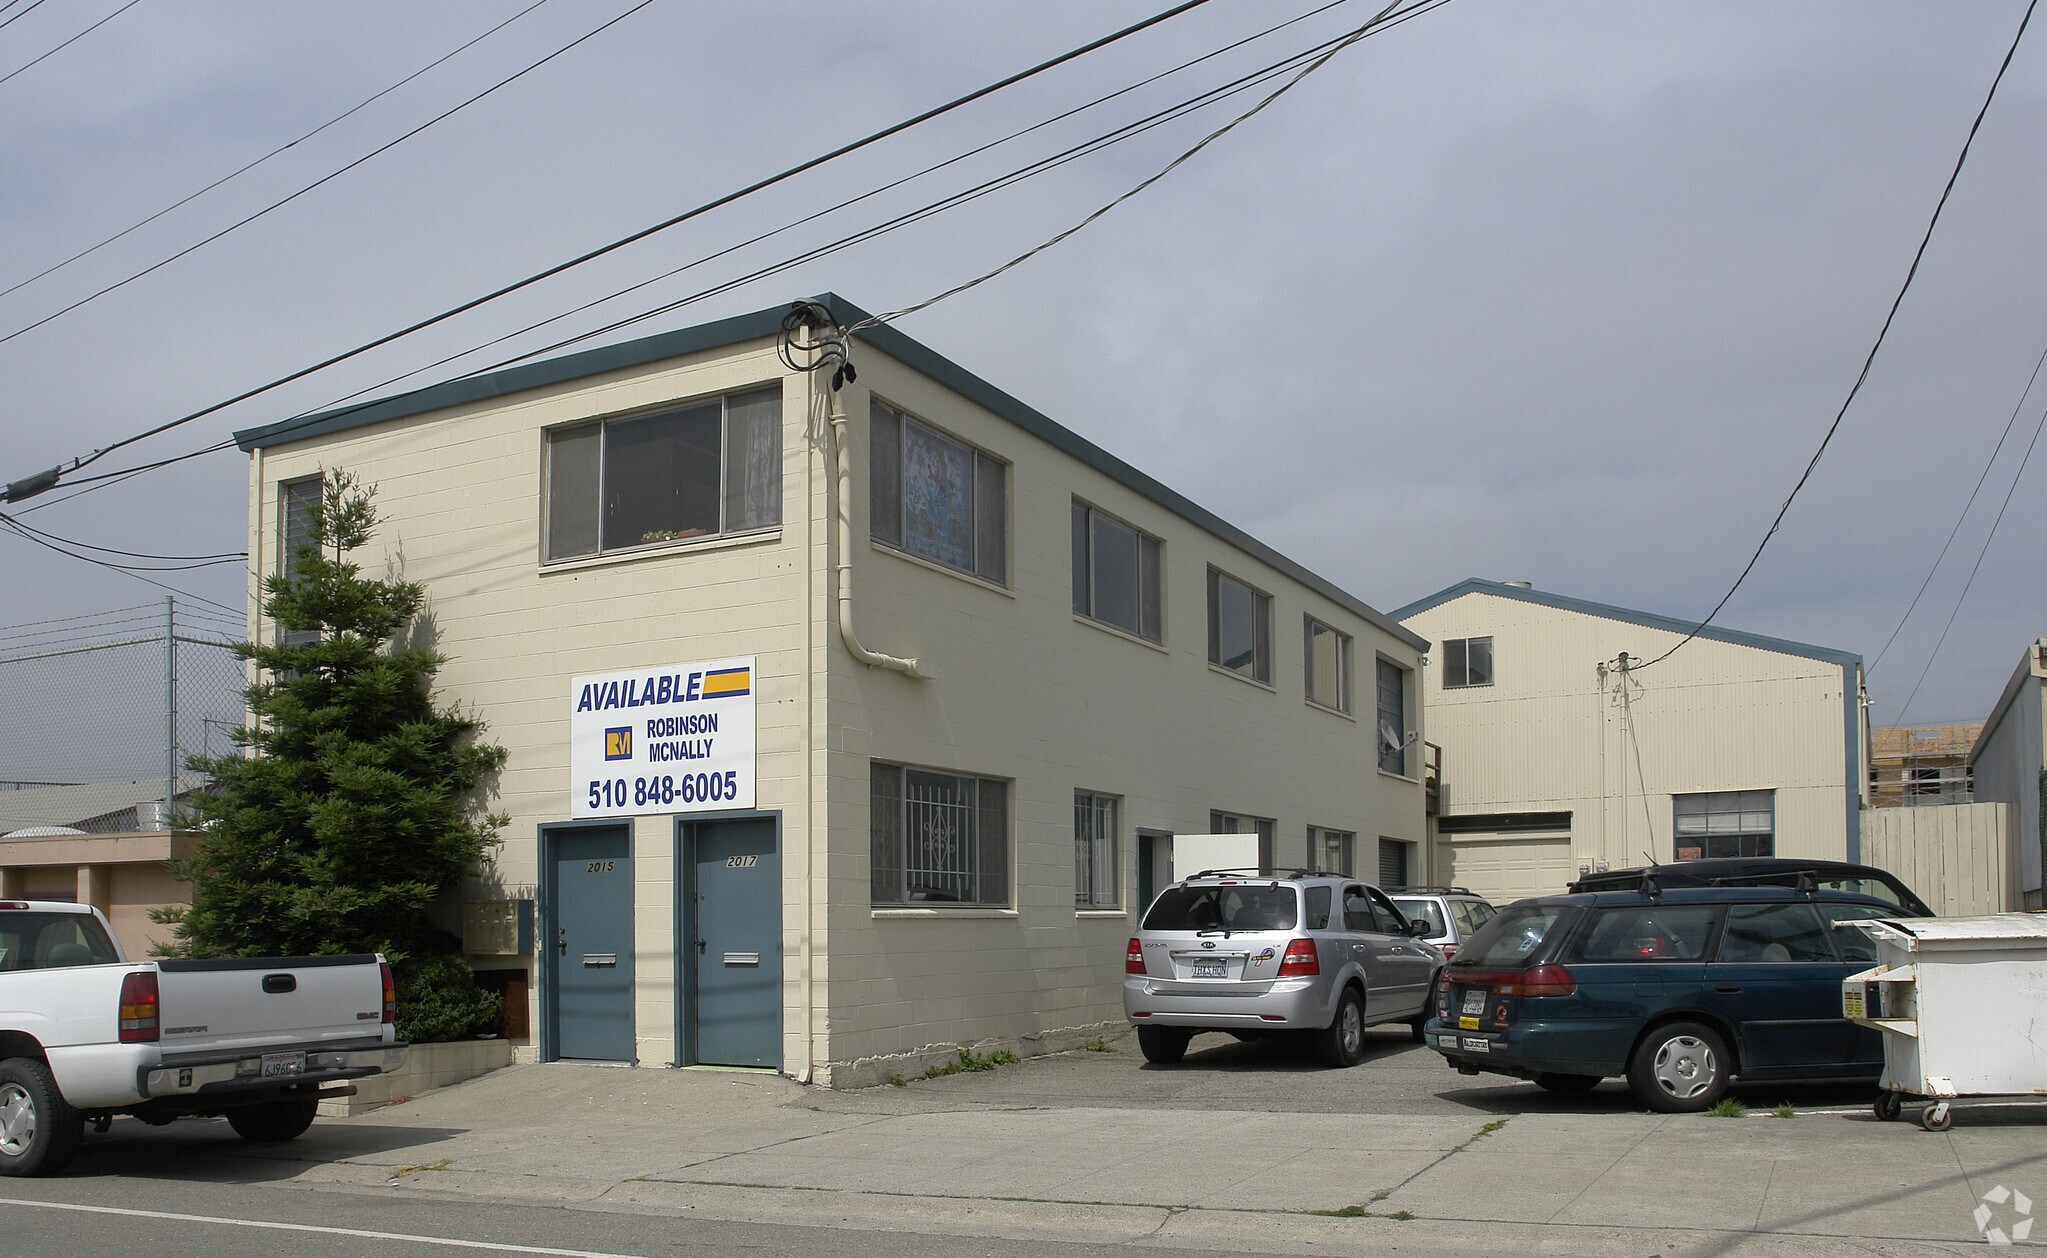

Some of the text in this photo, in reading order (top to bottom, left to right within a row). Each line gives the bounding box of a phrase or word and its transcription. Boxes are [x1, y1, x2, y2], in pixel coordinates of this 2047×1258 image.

[577, 672, 702, 712] AVAILABLE
[647, 713, 718, 738] ROBINSON
[649, 738, 713, 762] MCNALLY
[589, 771, 737, 809] 510 848-6005
[588, 862, 614, 872] 2015
[728, 856, 756, 867] 2017
